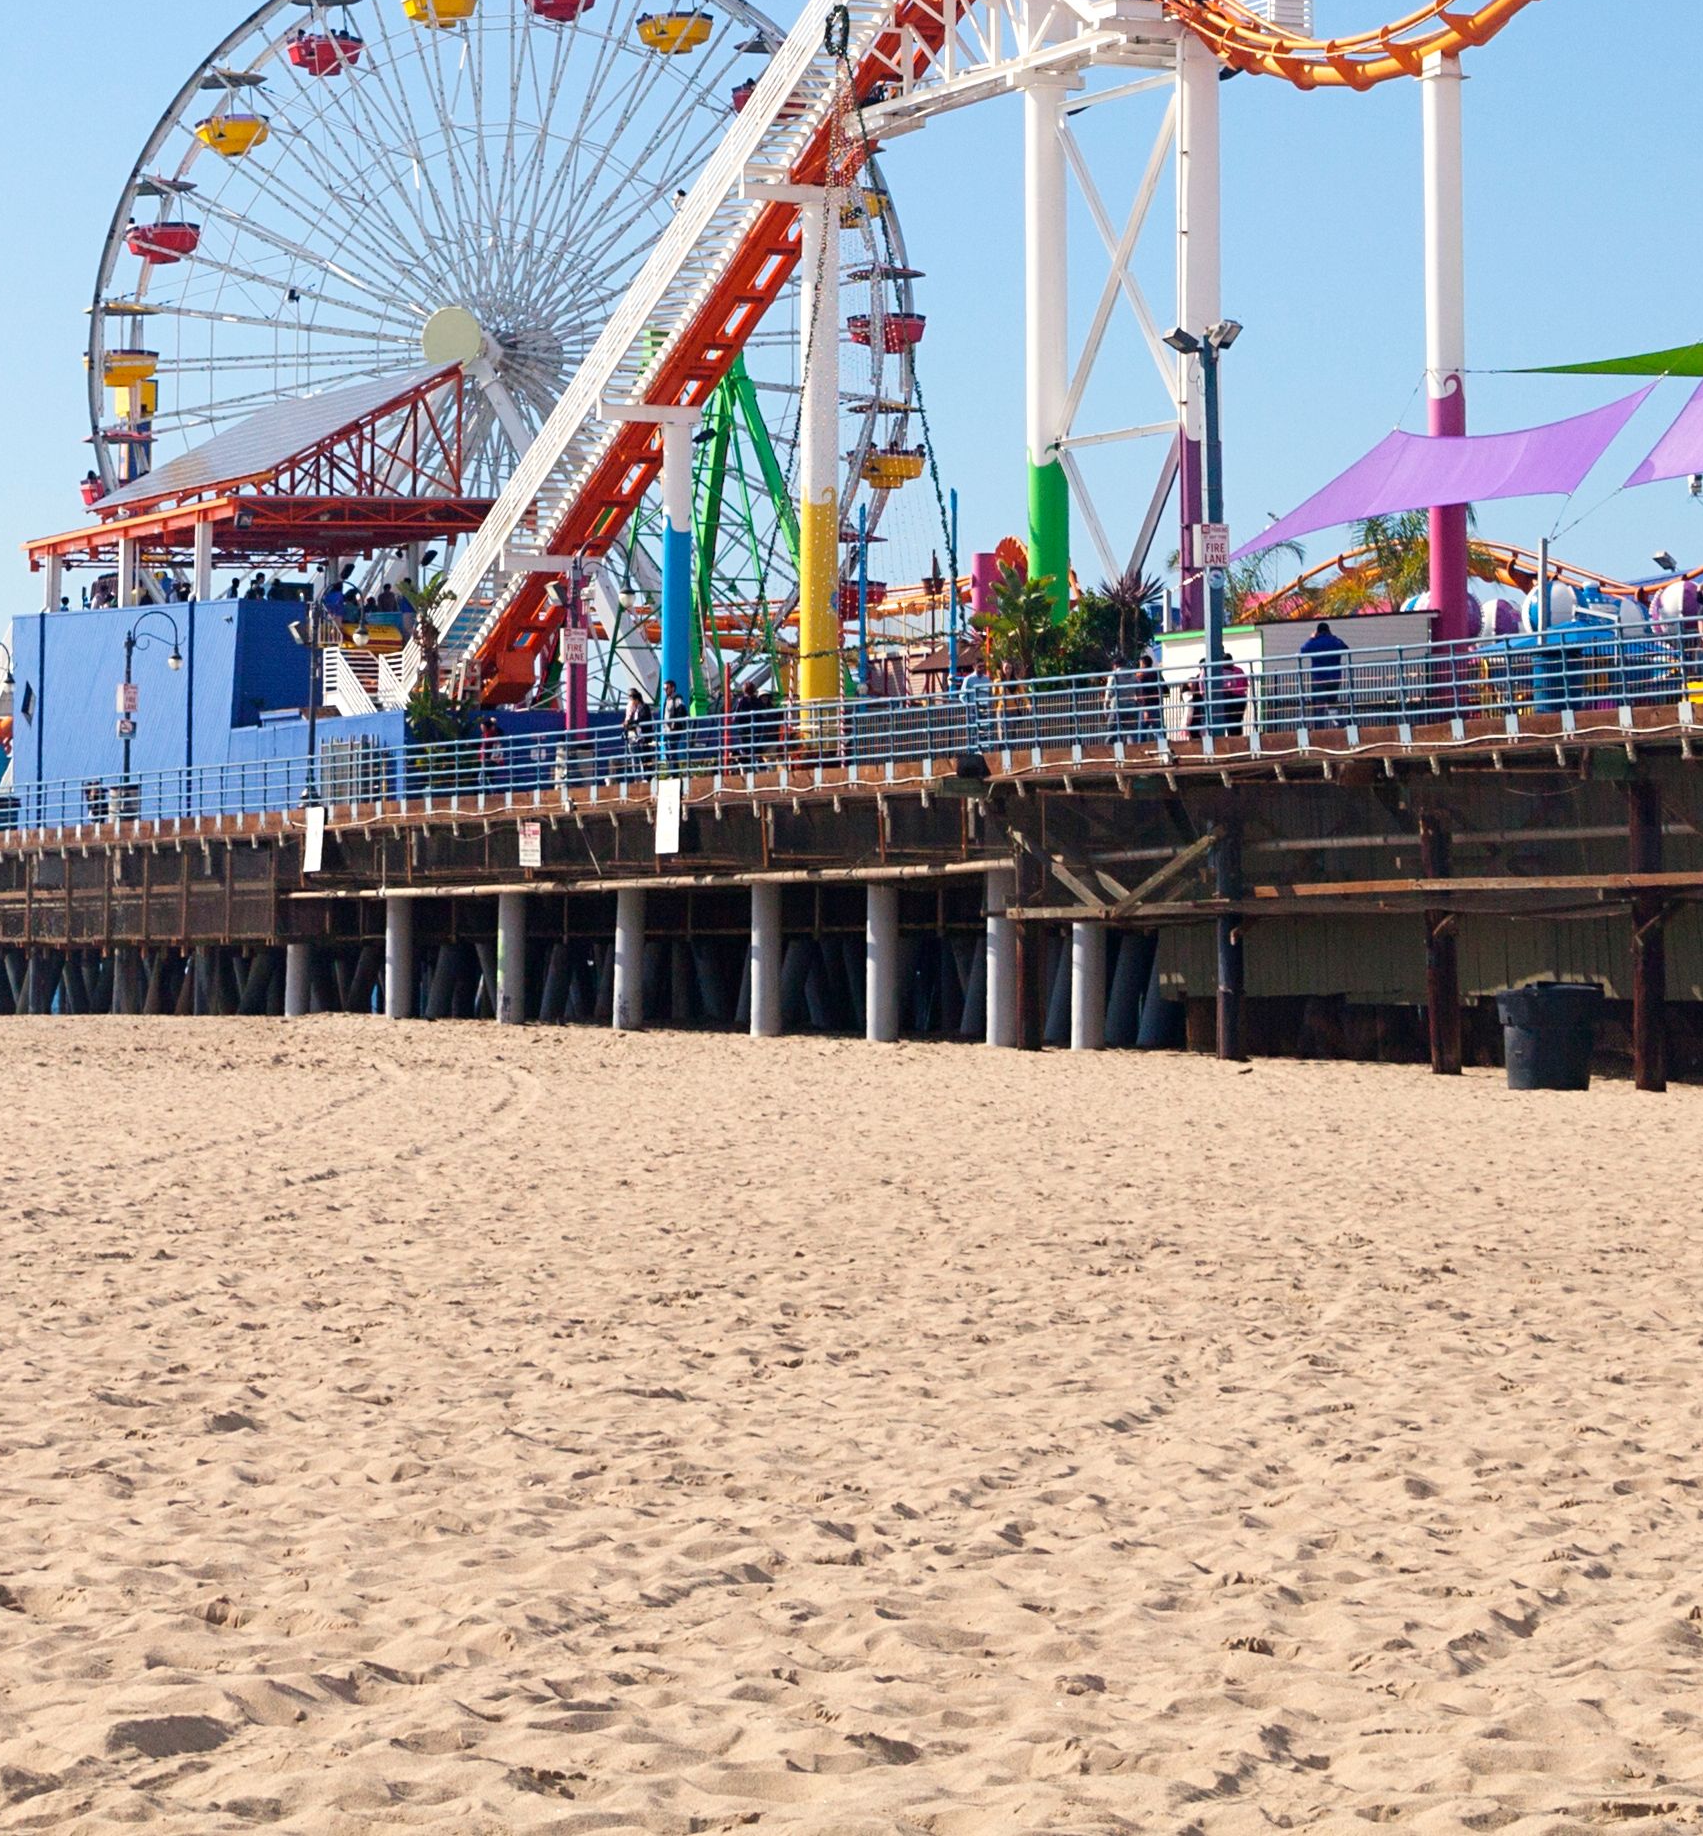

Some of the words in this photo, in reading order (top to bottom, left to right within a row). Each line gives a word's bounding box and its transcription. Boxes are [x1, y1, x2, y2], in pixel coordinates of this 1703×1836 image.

[1206, 543, 1225, 553] FIRE
[1204, 553, 1227, 564] LANE
[567, 643, 584, 653] FIRE
[565, 653, 585, 662] LANE
